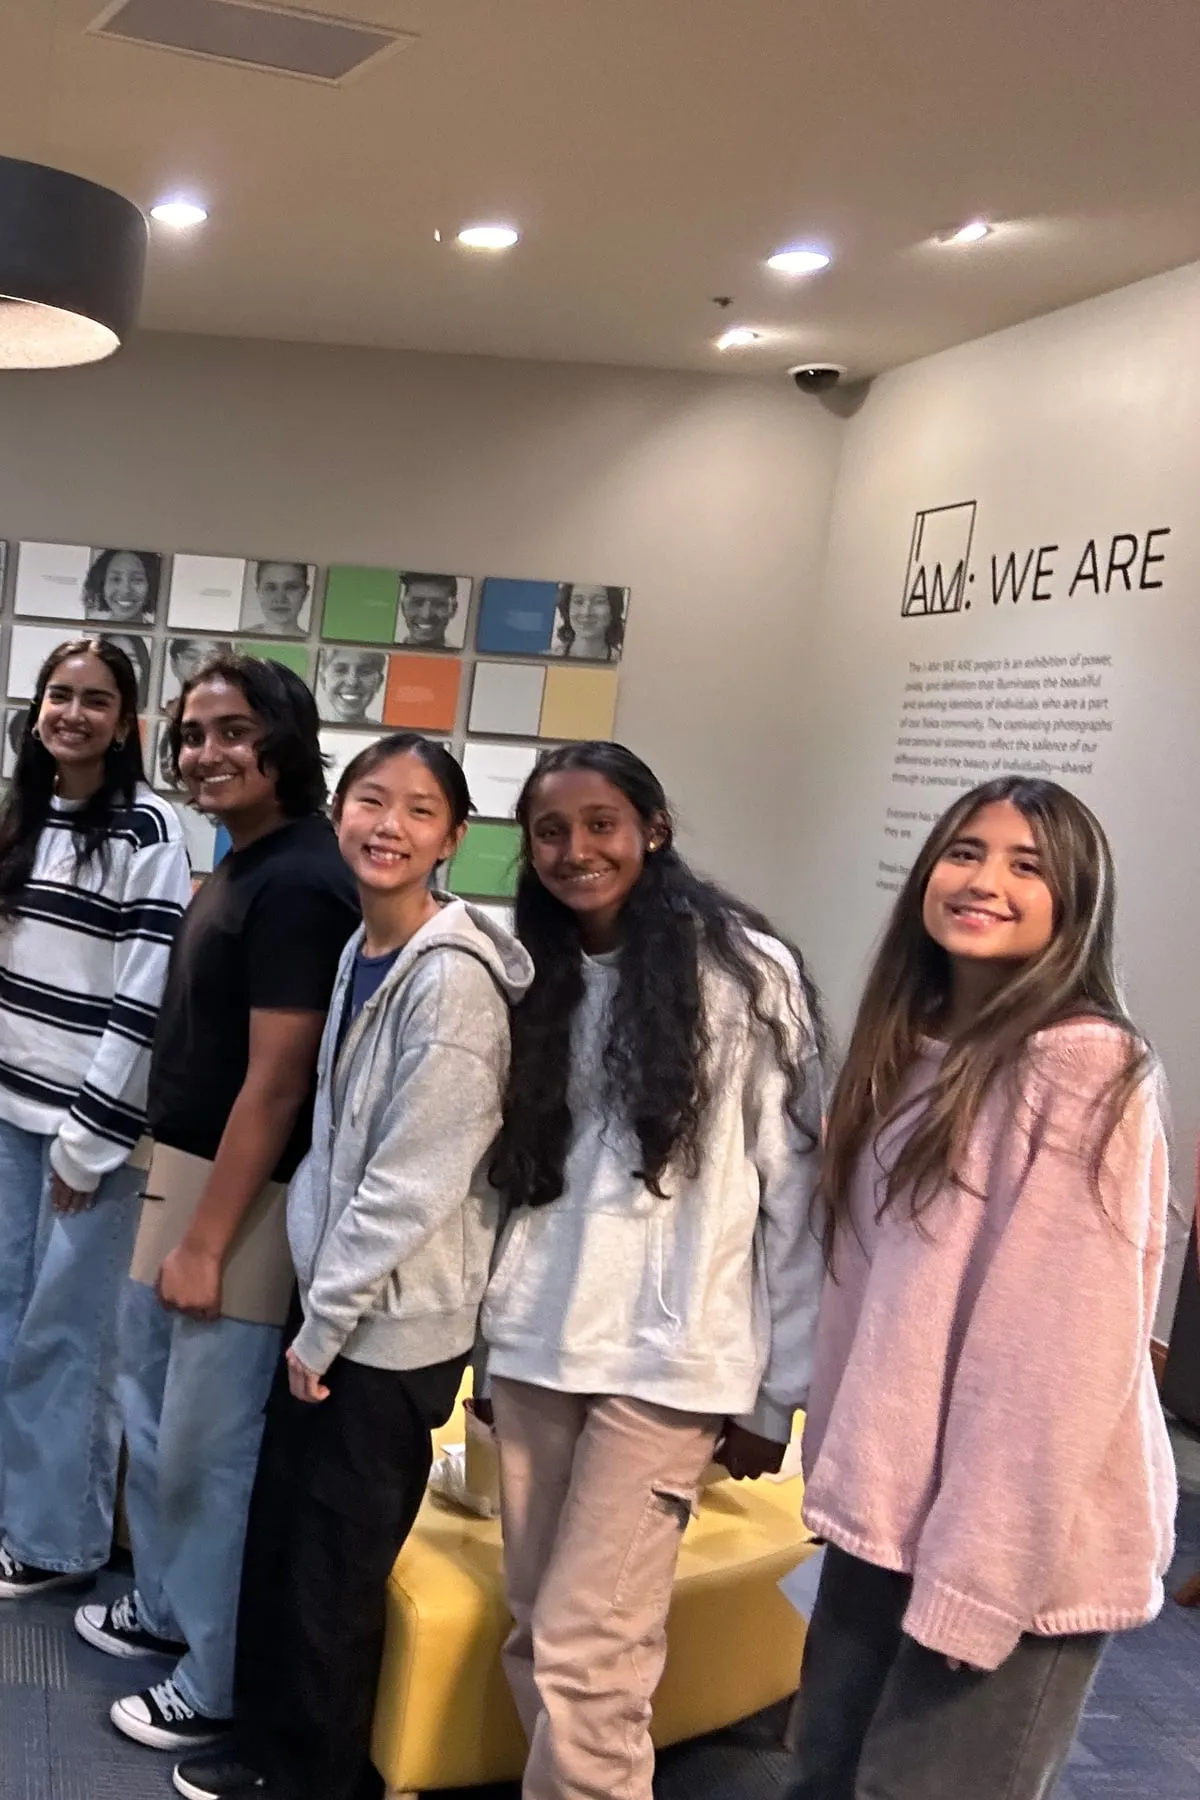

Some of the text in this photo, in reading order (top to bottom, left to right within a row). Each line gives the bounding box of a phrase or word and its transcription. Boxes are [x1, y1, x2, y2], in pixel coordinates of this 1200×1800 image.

[990, 545, 1059, 604] WE
[1068, 527, 1171, 597] ARE
[942, 660, 956, 672] WE
[957, 660, 973, 672] ARE
[974, 660, 1002, 674] project
[1012, 659, 1023, 669] an
[1024, 655, 1068, 669] exhibition
[1069, 653, 1081, 668] of
[978, 679, 994, 690] that
[996, 677, 1041, 690] illuminates
[1043, 676, 1058, 689] the
[1060, 673, 1102, 689] beautiful
[985, 697, 995, 711] of
[996, 697, 1040, 710] individuals
[1042, 697, 1061, 710] who
[1062, 698, 1078, 710] are
[1079, 699, 1086, 710] a
[1088, 698, 1109, 712] part
[987, 716, 1003, 730] The
[1004, 719, 1052, 734] captivating
[1053, 718, 1113, 734] photographs
[1016, 739, 1031, 752] the
[1032, 738, 1068, 752] salience
[1069, 739, 1081, 752] of
[1081, 742, 1099, 753] our
[991, 757, 1002, 770] of
